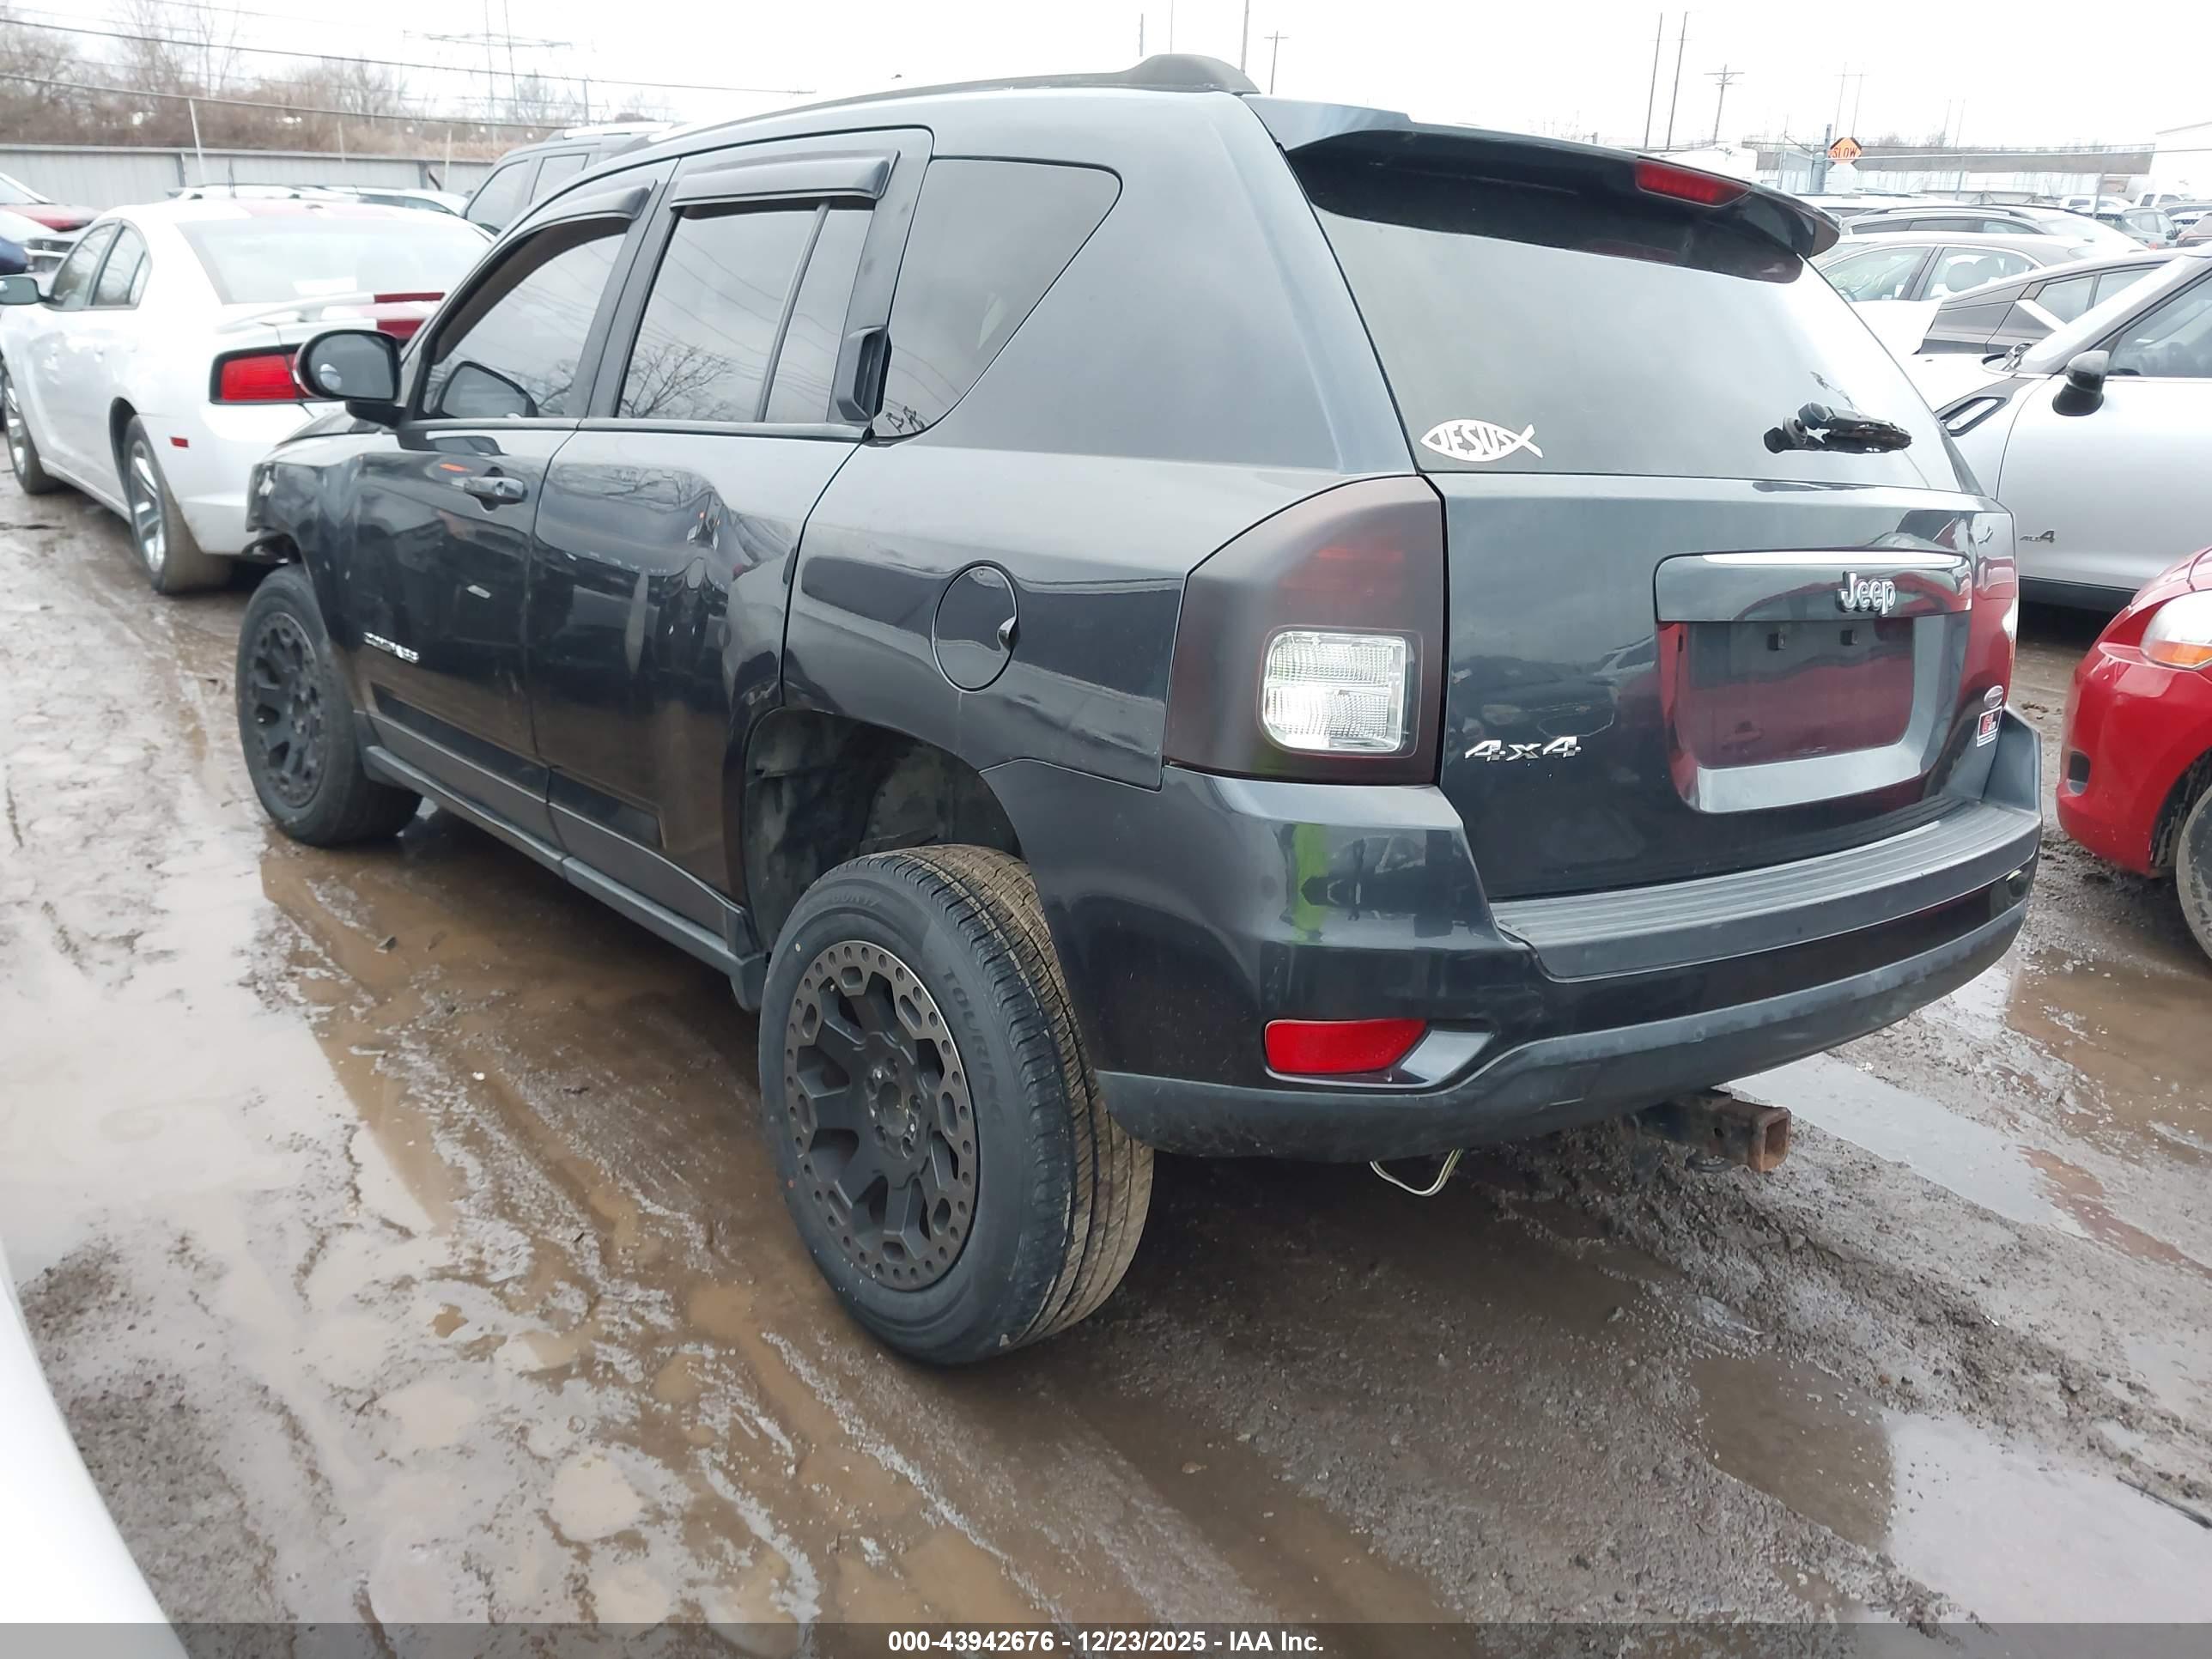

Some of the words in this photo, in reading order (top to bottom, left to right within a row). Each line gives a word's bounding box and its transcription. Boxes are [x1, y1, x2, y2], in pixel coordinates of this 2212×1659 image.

[1832, 146, 1858, 159] SLOW
[1428, 424, 1516, 455] JESUS
[1838, 570, 1896, 617] Jeep
